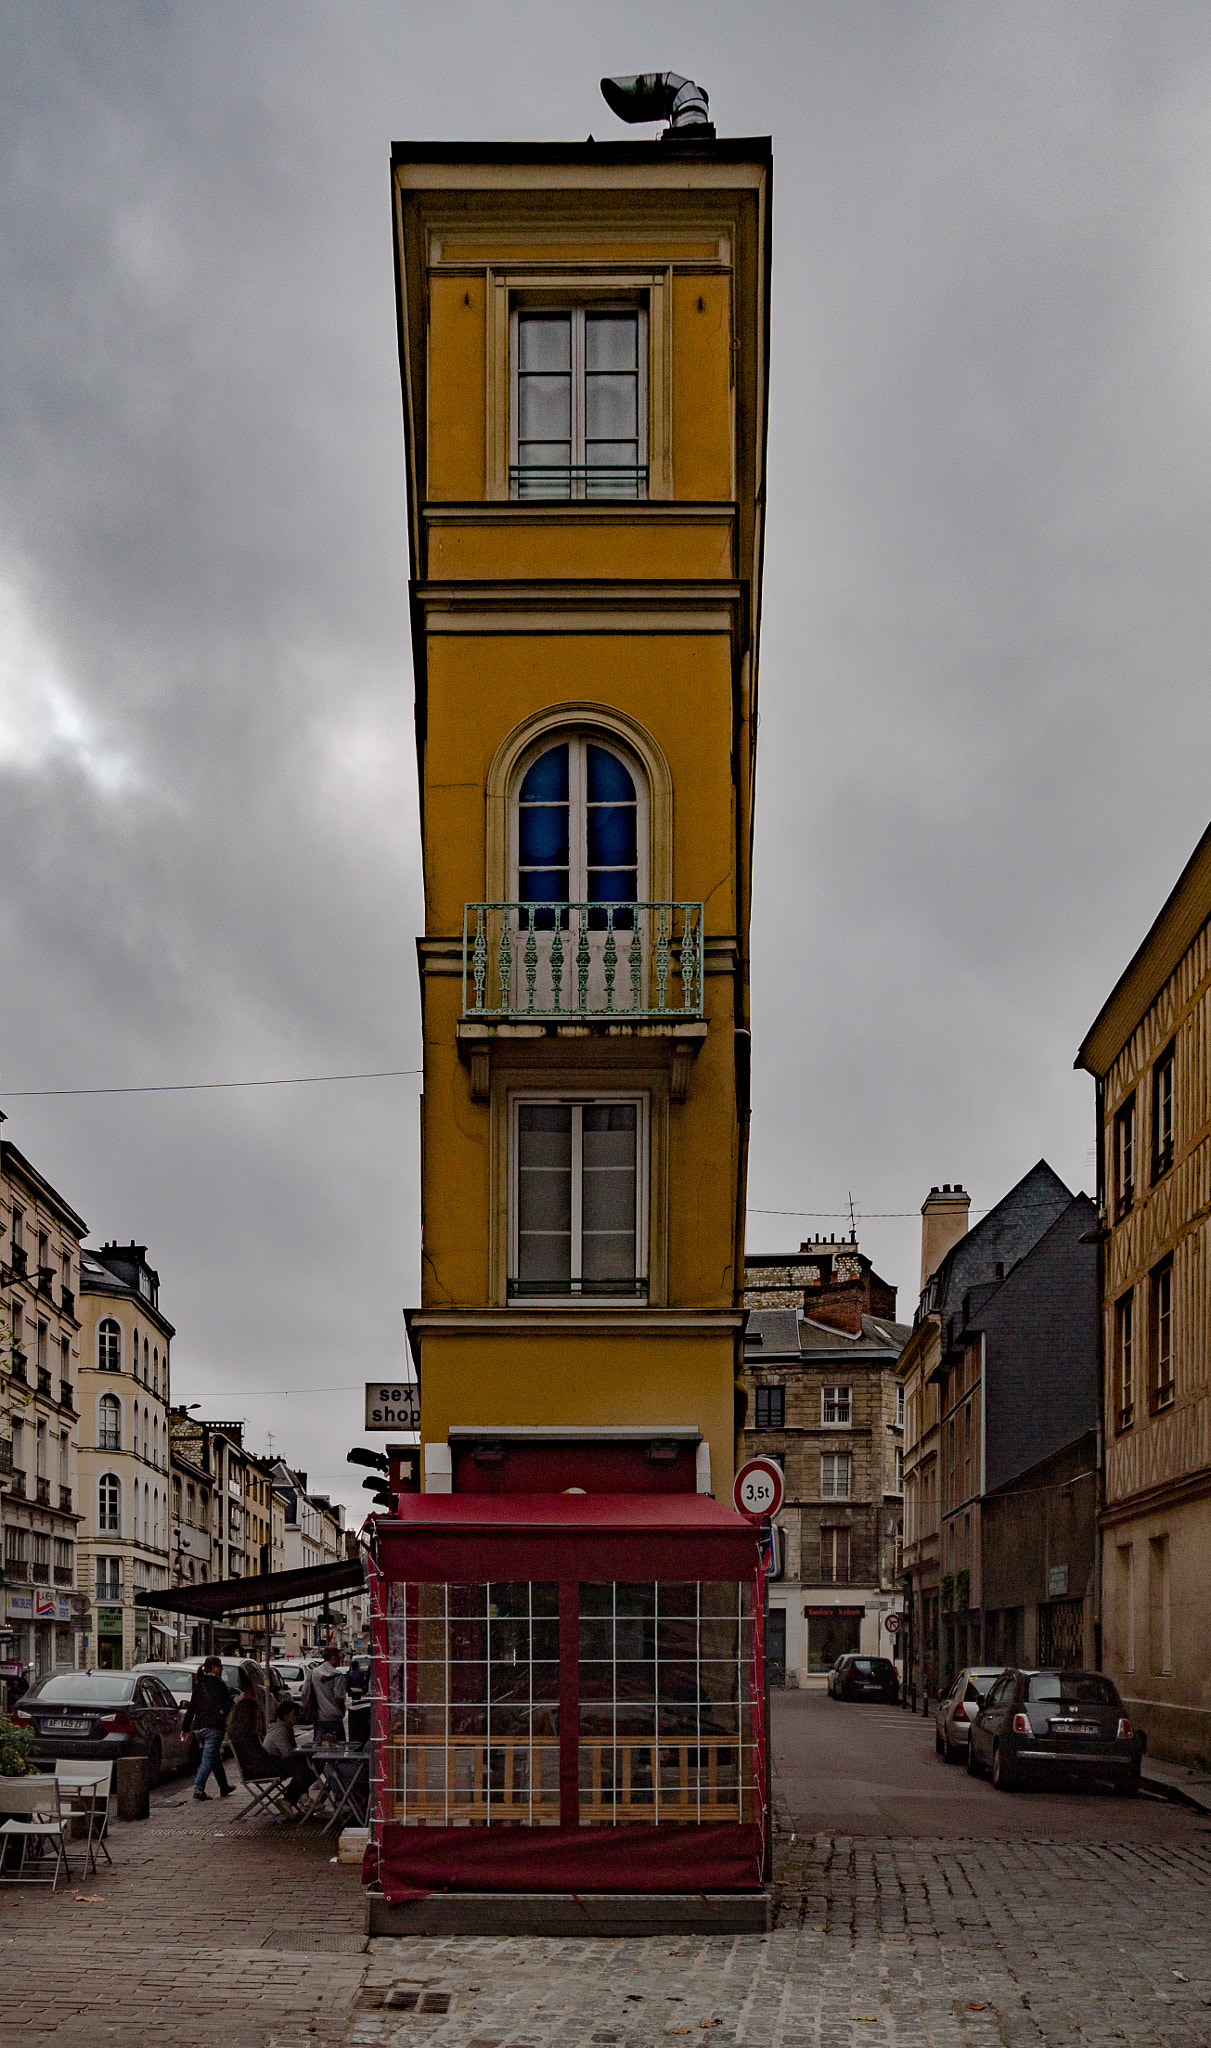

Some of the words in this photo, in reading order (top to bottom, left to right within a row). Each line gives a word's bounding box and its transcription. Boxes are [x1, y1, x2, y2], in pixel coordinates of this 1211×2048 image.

[380, 1389, 414, 1401] sex
[372, 1406, 420, 1426] shop
[746, 1484, 770, 1501] 3,5t
